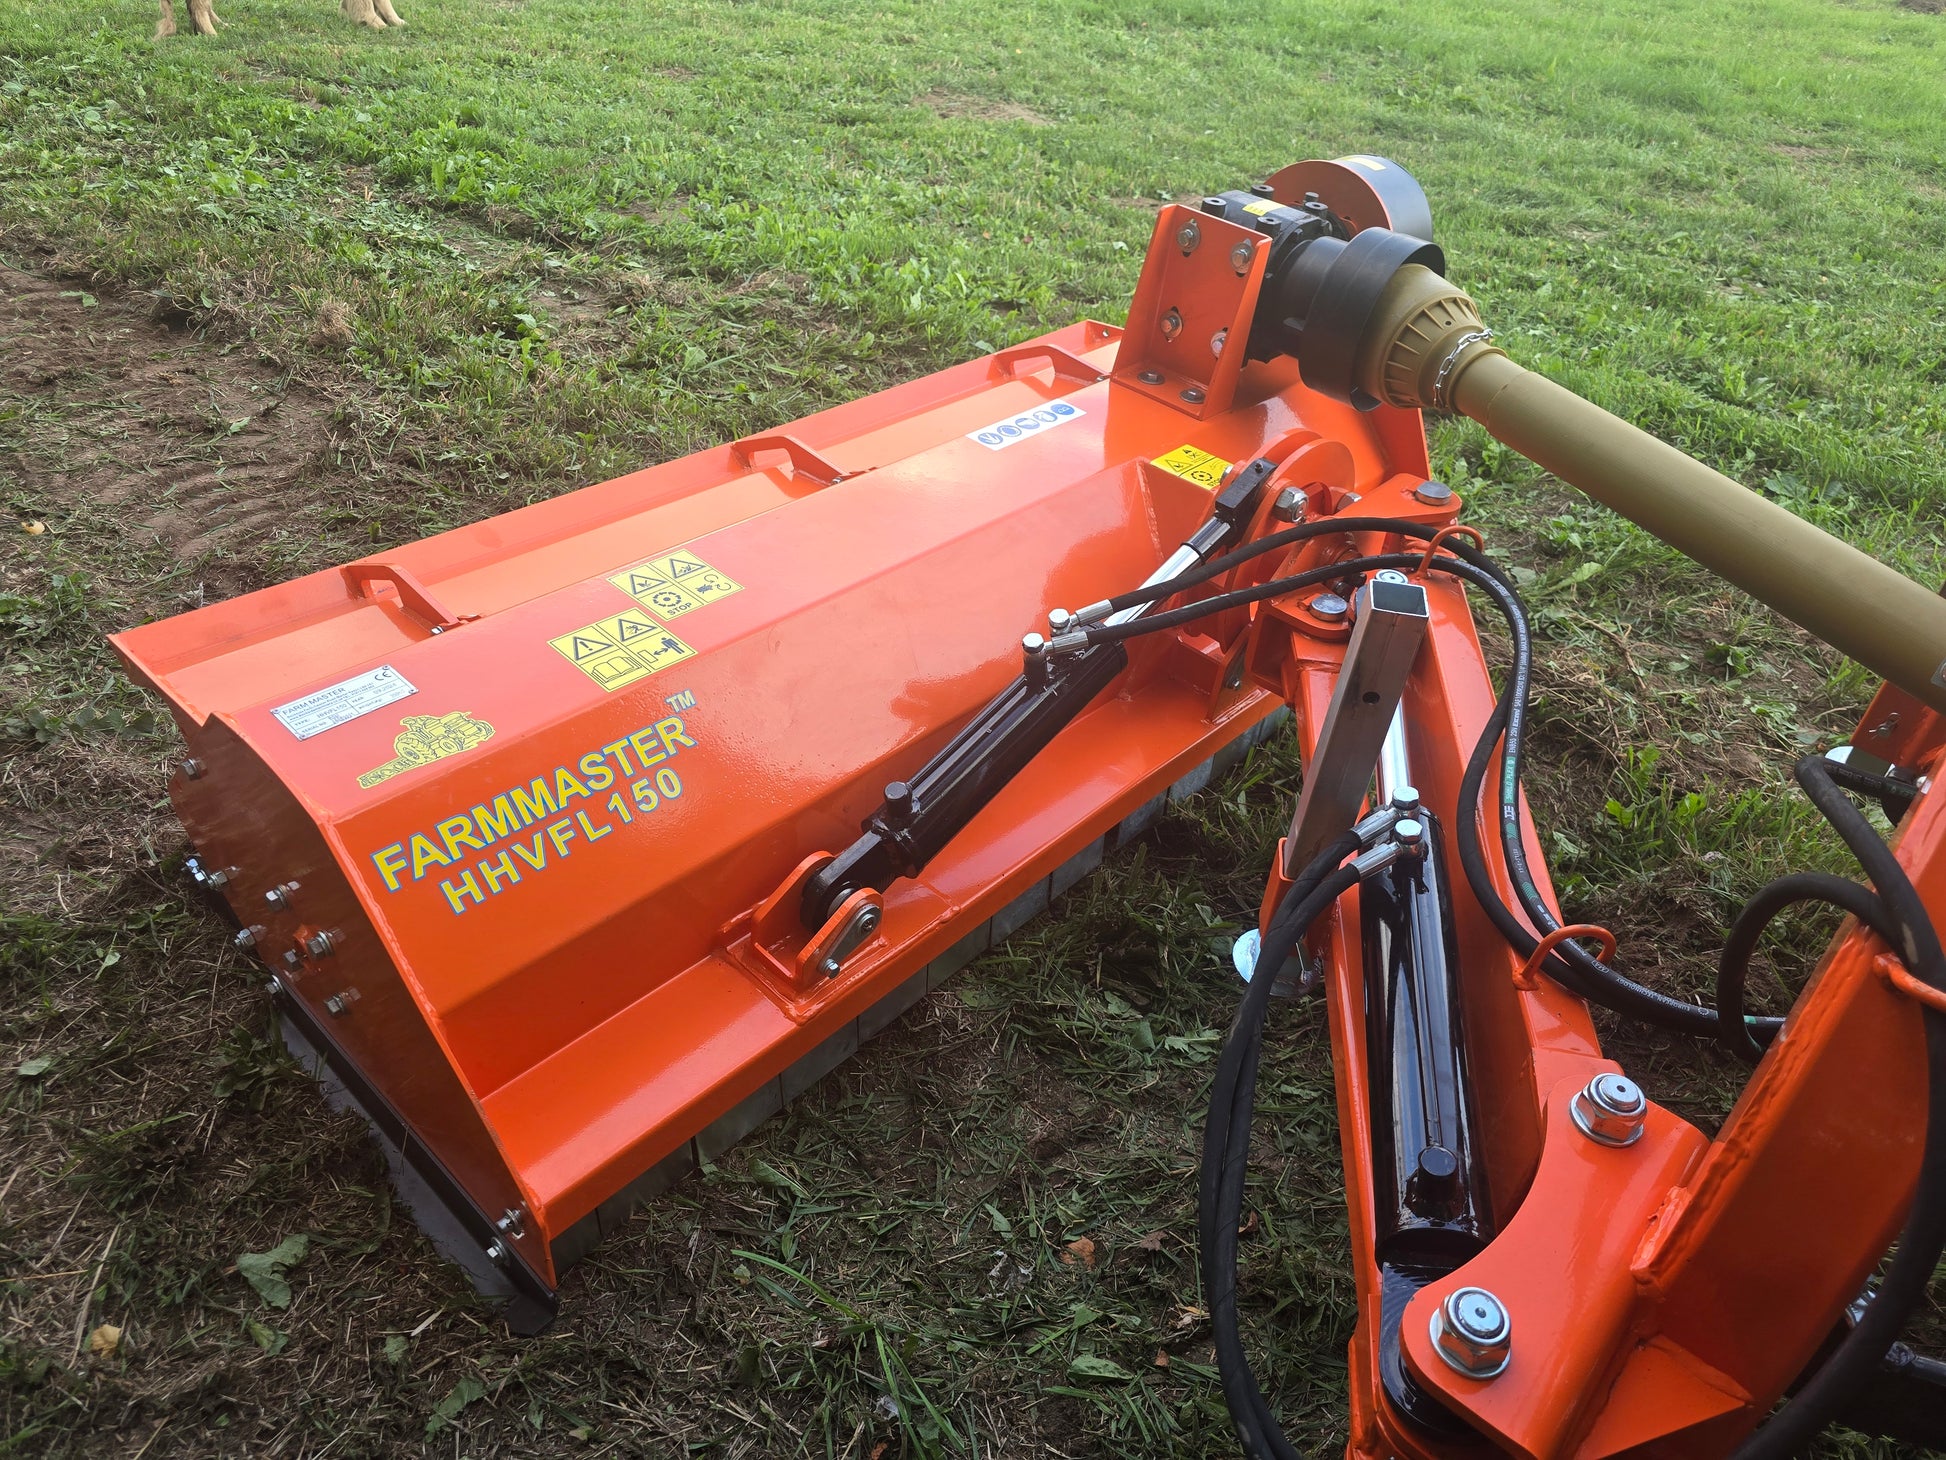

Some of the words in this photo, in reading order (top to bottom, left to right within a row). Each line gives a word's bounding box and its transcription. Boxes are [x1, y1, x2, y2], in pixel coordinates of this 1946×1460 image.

[667, 602, 692, 615] STOP
[282, 701, 308, 716] FARM
[308, 687, 346, 705] MASTER
[370, 715, 698, 893] FARMMASTER
[665, 689, 696, 712] TM
[440, 767, 683, 915] HHVFL150
